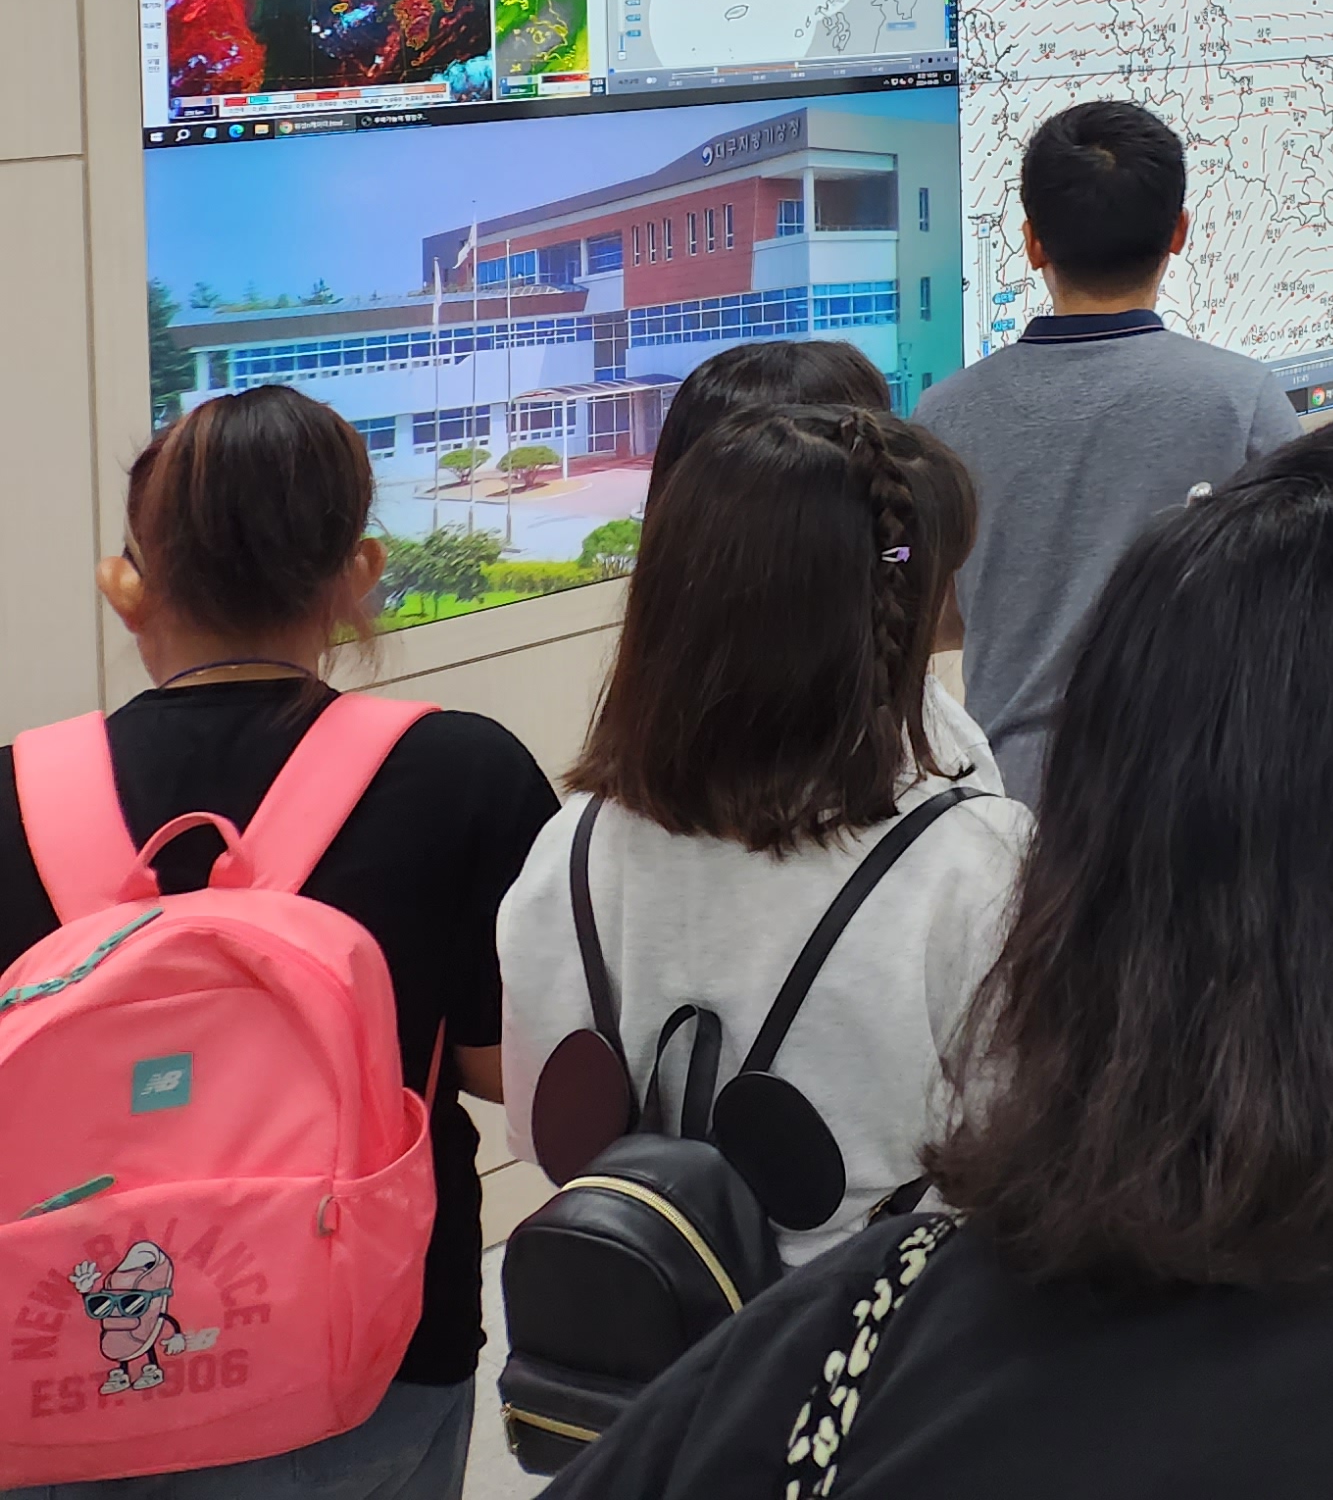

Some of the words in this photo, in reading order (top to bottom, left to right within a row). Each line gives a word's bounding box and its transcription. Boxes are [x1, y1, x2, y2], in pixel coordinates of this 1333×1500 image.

[1257, 27, 1272, 39] 상주
[1260, 96, 1275, 107] 김천
[1283, 91, 1298, 101] 구미
[715, 117, 801, 159] 대구지방기상청
[1202, 297, 1227, 309] 지리산
[10, 1268, 73, 1362] NEW
